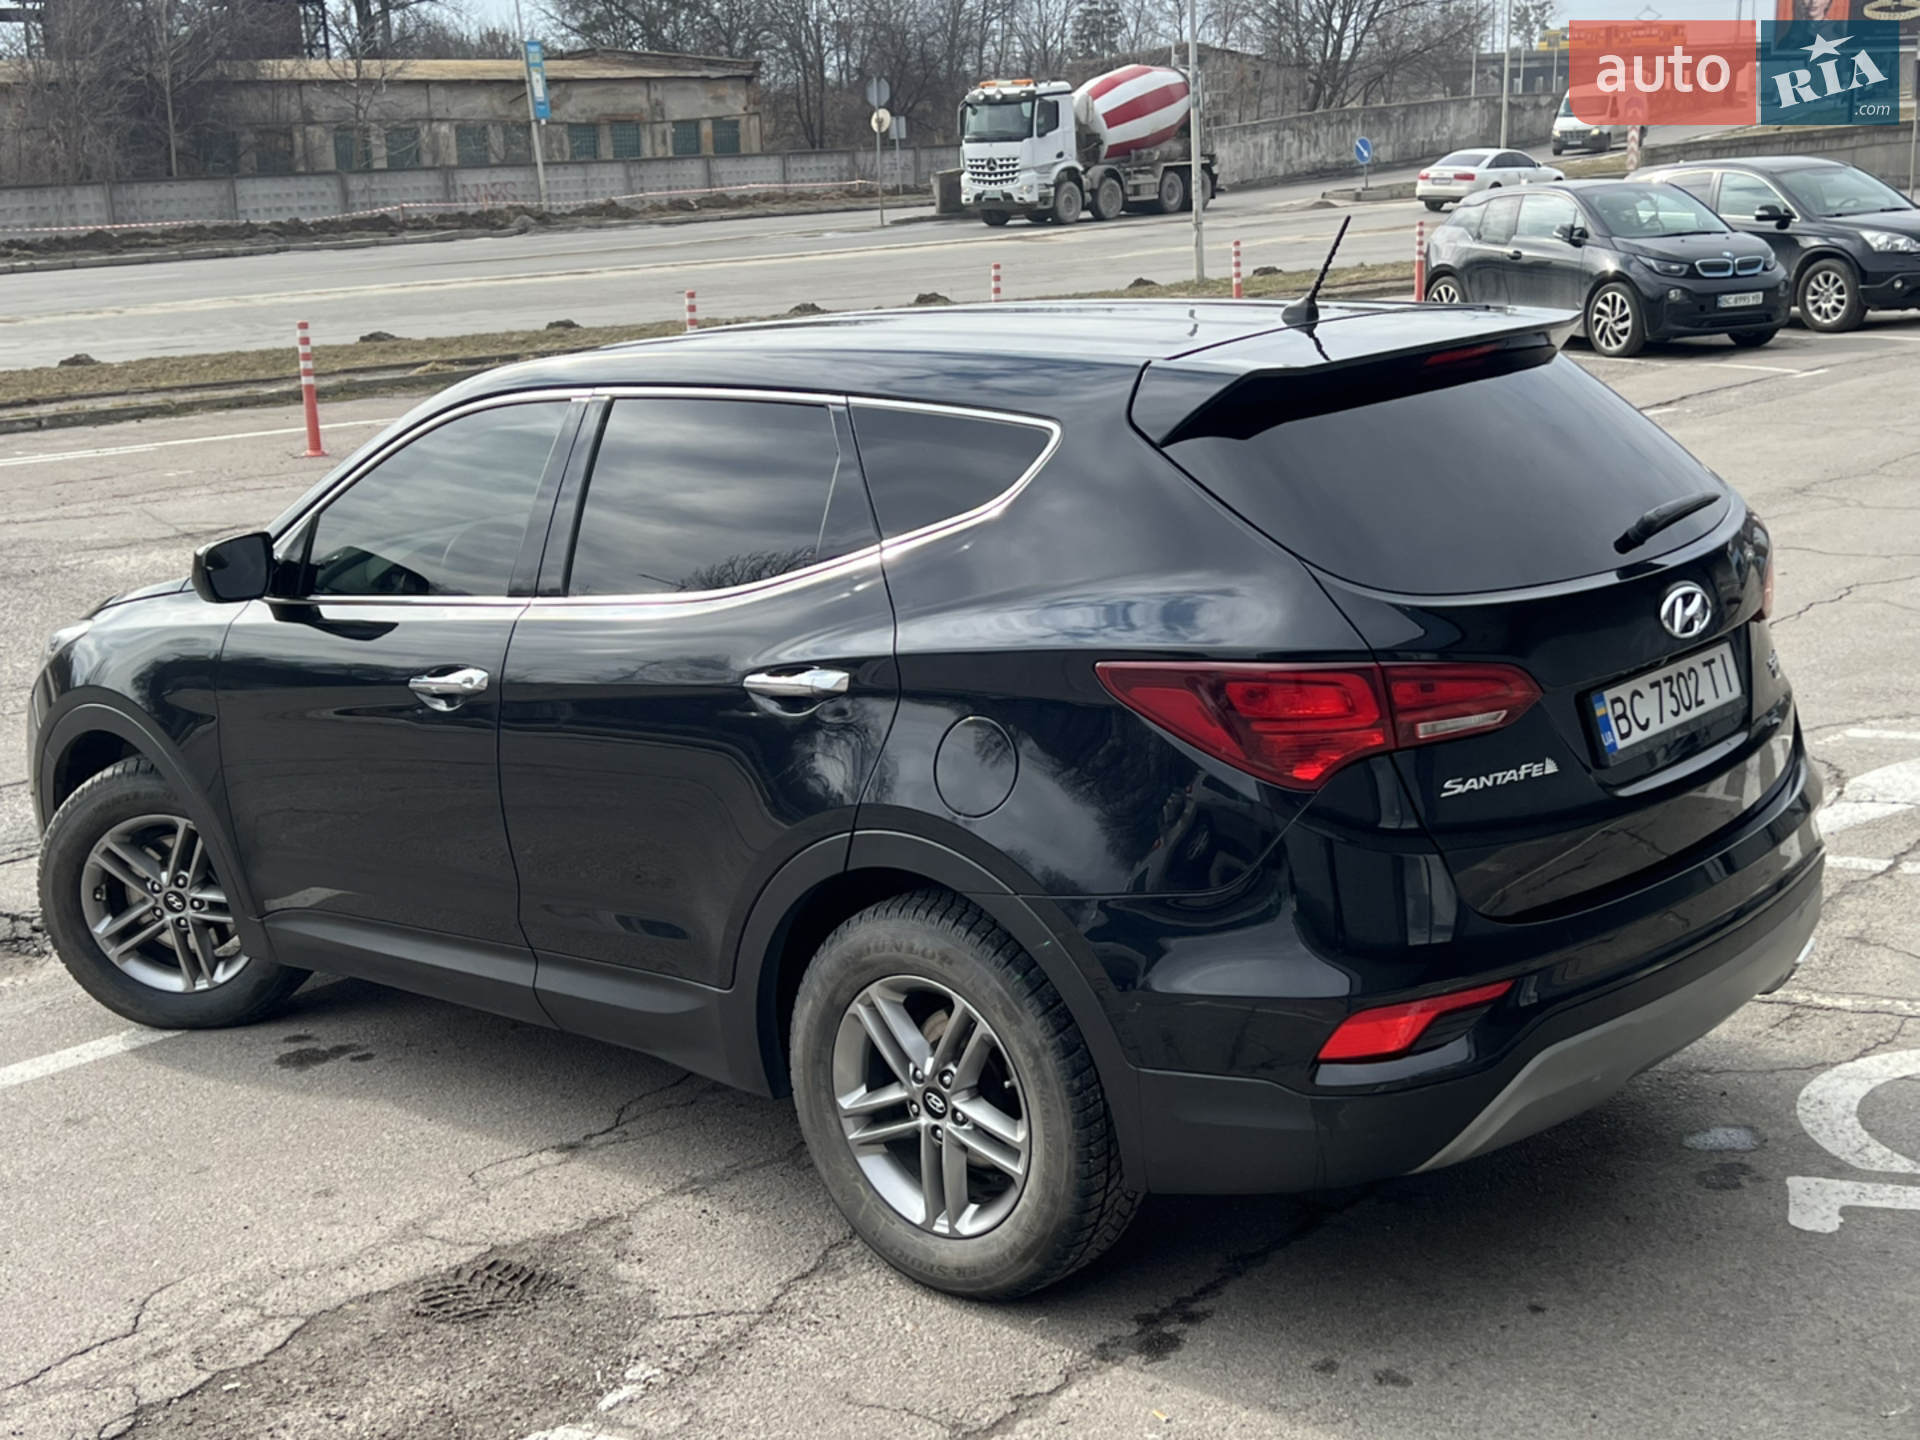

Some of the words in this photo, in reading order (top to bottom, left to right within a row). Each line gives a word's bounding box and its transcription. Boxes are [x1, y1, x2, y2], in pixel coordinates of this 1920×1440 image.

[1610, 689, 1650, 741] BC
[1649, 667, 1705, 727] 7302
[1702, 652, 1734, 699] TI
[1601, 731, 1615, 747] UA
[858, 938, 955, 969] DUNLOP
